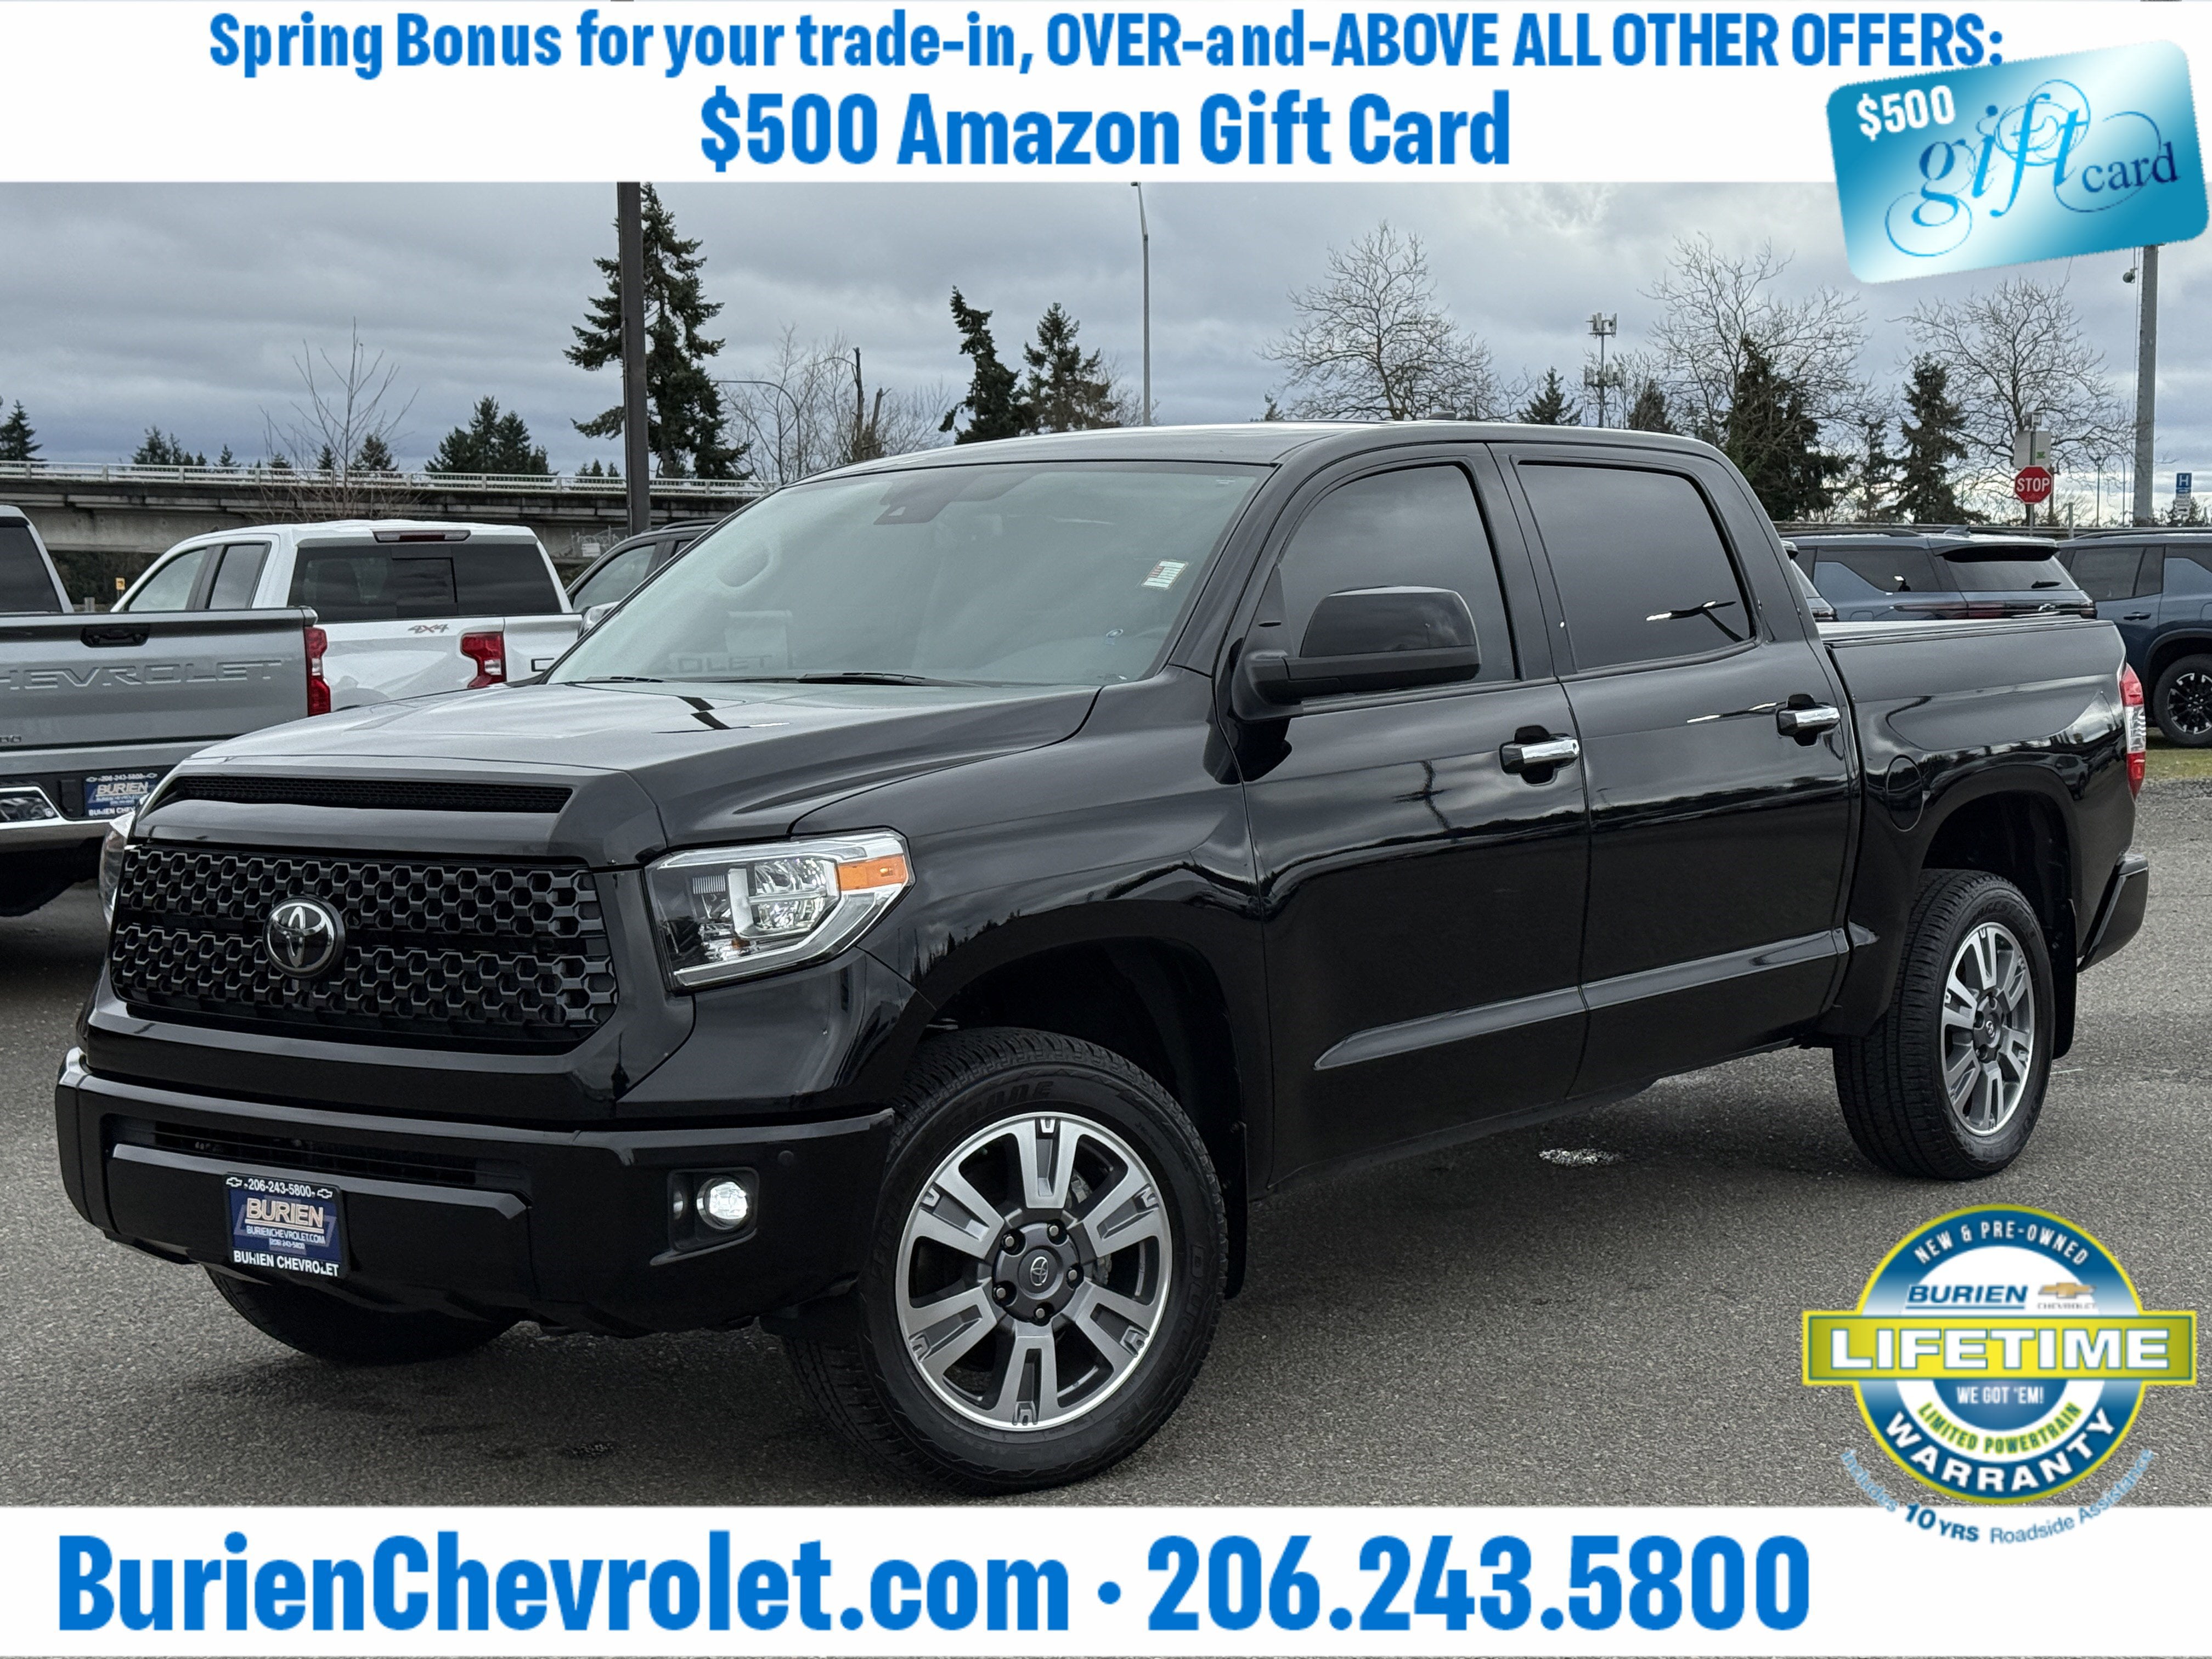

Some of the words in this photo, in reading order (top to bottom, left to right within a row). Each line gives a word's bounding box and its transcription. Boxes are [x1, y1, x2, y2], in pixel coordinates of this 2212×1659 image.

[2017, 477, 2051, 493] STOP
[2179, 475, 2189, 487] H
[98, 782, 148, 795] BURIEN
[246, 1197, 324, 1228] BURIEN
